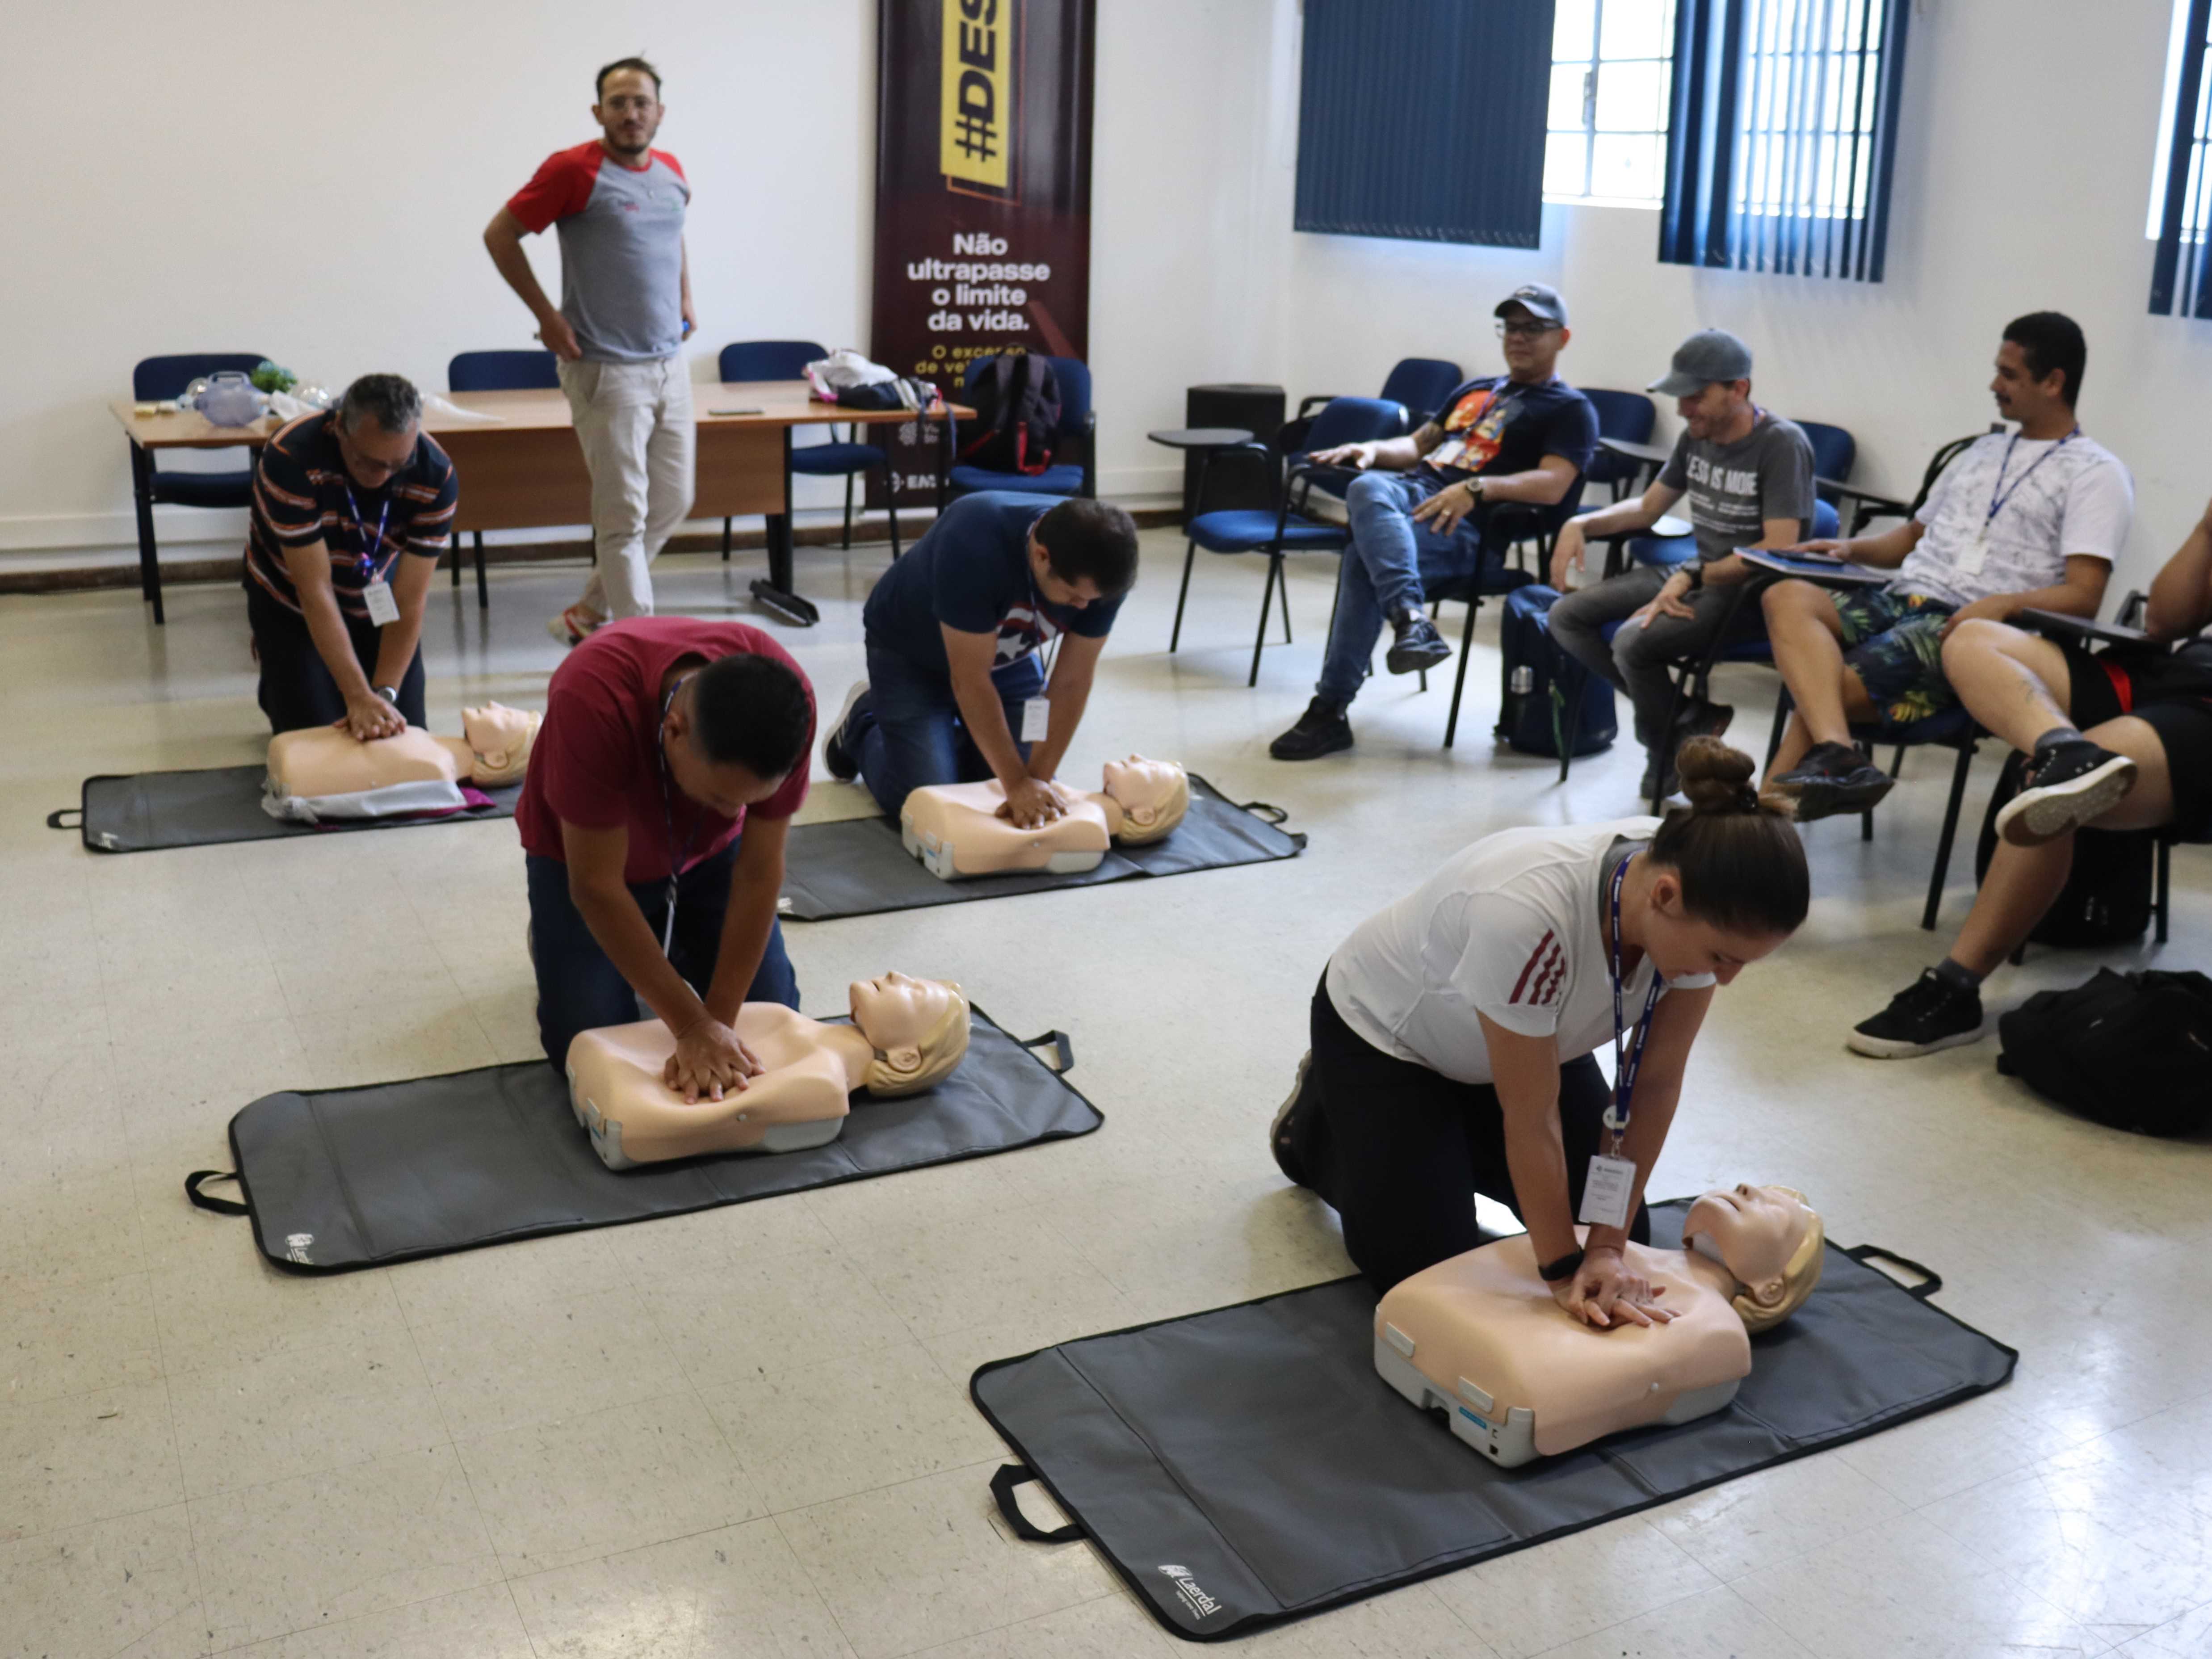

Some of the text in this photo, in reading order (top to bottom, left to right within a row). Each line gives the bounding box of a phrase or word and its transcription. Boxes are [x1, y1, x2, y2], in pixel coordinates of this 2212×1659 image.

[953, 232, 1008, 256] Não
[907, 257, 1051, 285] ultrapasse
[932, 283, 1027, 306] o limite
[928, 308, 1030, 332] da vida.
[932, 344, 947, 359] O
[915, 359, 938, 374] de
[1178, 1577, 1222, 1616] Laerdal
